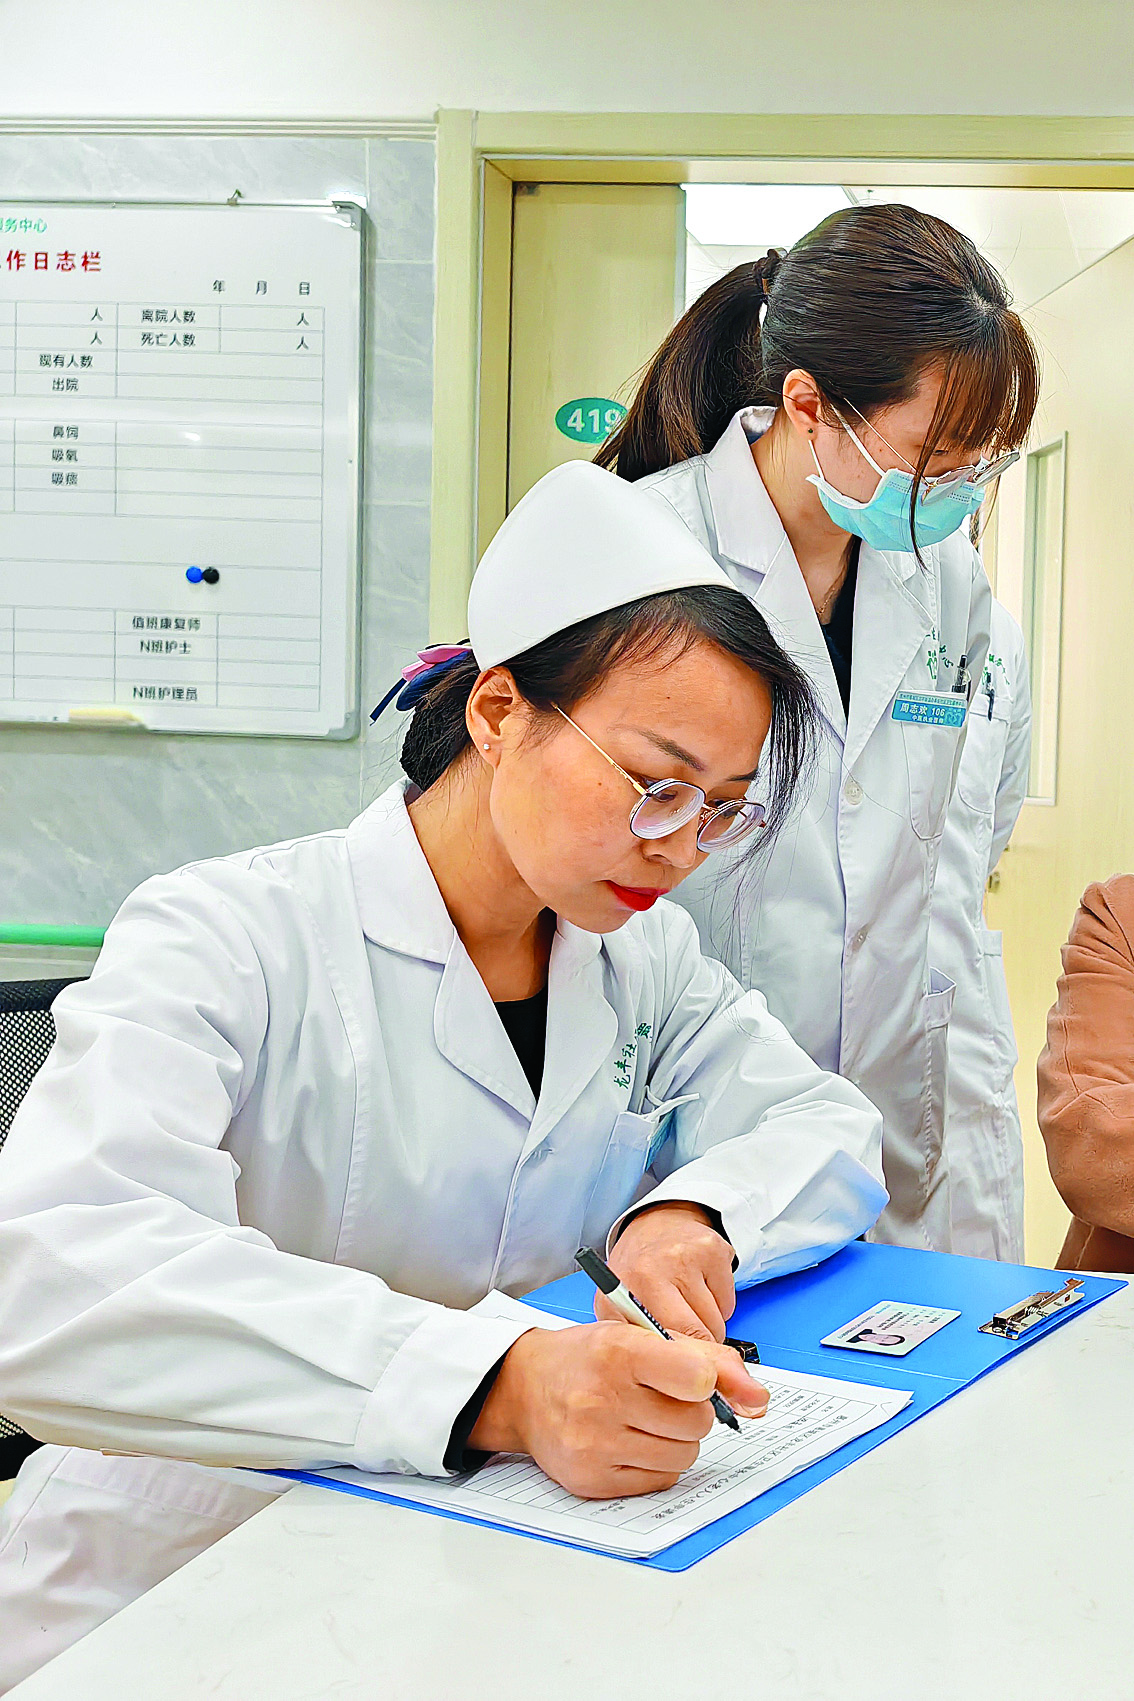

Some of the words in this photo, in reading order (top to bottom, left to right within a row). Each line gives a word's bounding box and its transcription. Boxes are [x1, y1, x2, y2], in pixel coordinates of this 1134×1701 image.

[0, 218, 47, 233] 务中心
[0, 250, 101, 272] 作日志栏
[256, 281, 268, 295] 月
[299, 282, 310, 296] 日
[90, 307, 103, 323] 人
[141, 309, 196, 324] 离院人数
[296, 312, 310, 327] 人
[90, 331, 103, 346] 人
[141, 332, 196, 347] 死亡人数
[296, 336, 310, 351] 人
[39, 354, 93, 368] 现有人数
[52, 378, 79, 392] 出院
[567, 407, 621, 434] 419
[140, 640, 191, 654] N班护士
[133, 686, 198, 701] N班护理员
